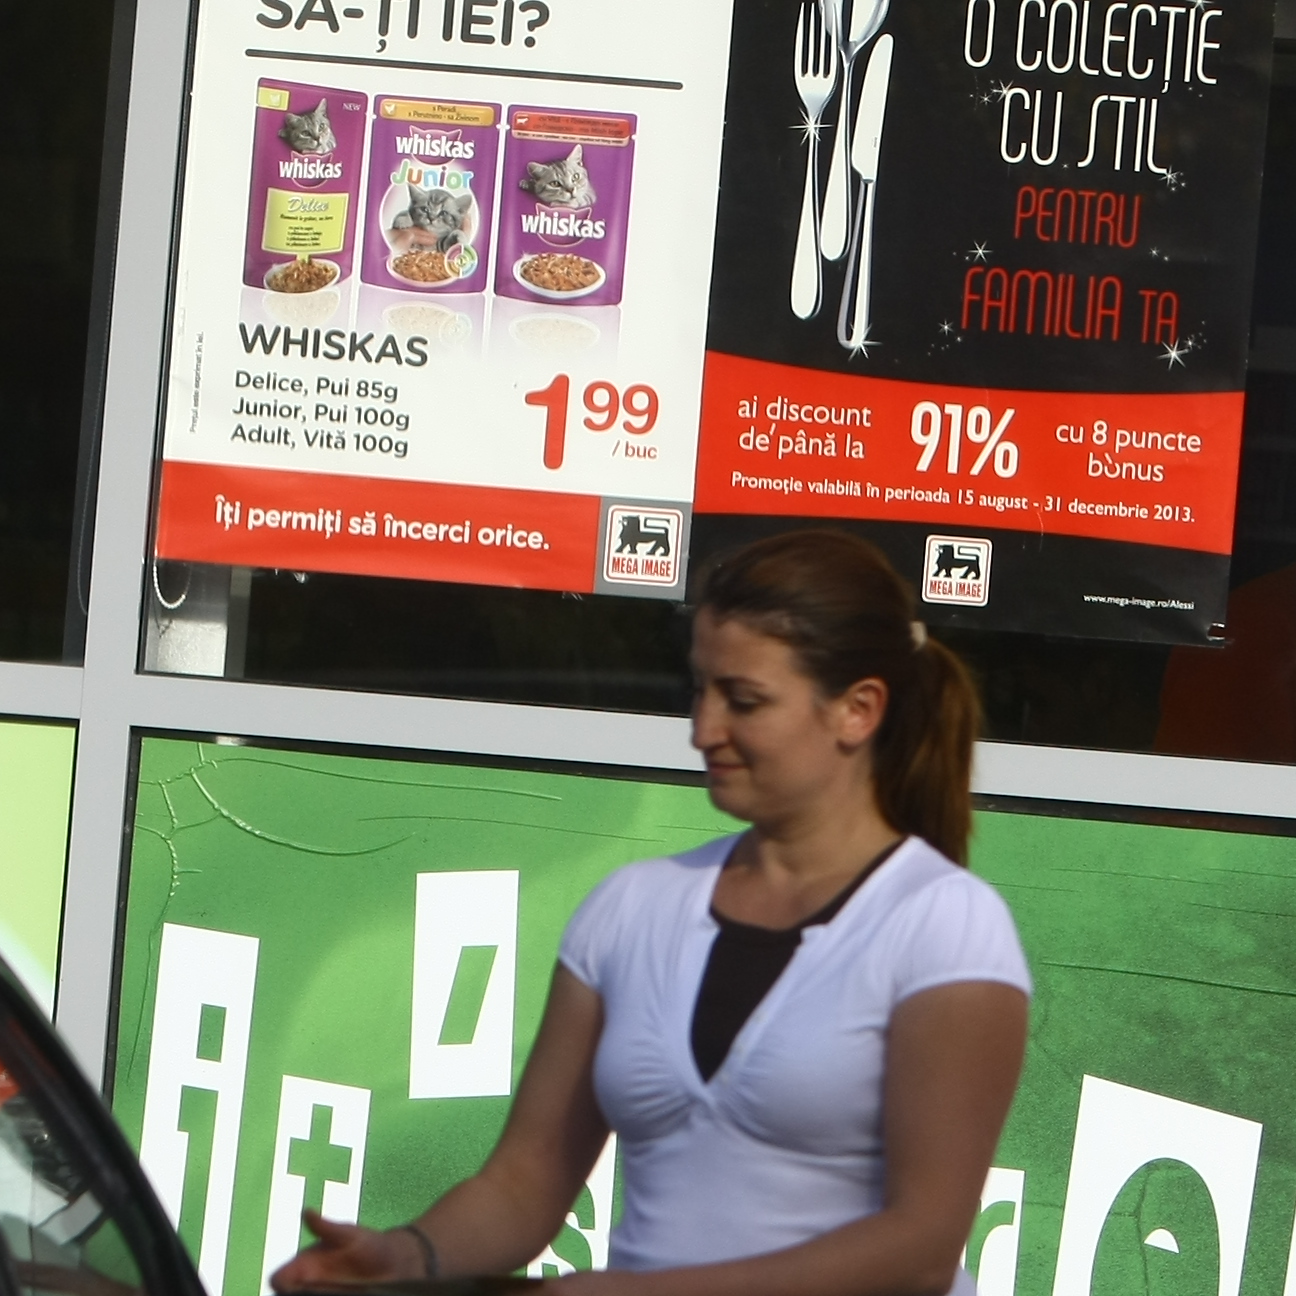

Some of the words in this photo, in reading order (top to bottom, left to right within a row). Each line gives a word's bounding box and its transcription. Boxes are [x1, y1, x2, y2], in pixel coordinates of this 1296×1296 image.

[962, 0, 997, 69] O
[1014, 0, 1224, 93] COLECȚIE
[999, 87, 1063, 167] CU
[396, 133, 475, 159] whiskas
[279, 158, 343, 180] whiskas
[391, 159, 474, 190] Junior
[521, 211, 605, 239] whiskas
[1013, 185, 1142, 248] PENTRU
[961, 266, 1124, 341] FAMILIA
[1138, 288, 1180, 346] TA
[239, 322, 429, 367] WHISKAS
[235, 370, 308, 396] Delice,
[316, 376, 349, 397] Pui
[356, 379, 398, 403] 85g
[232, 397, 306, 424] Junior,
[315, 403, 348, 424] Pui
[355, 407, 410, 431] 100g
[737, 396, 758, 419] ai
[766, 396, 872, 428] discount
[231, 423, 296, 450] Adult,
[304, 429, 347, 450] Vită
[353, 433, 409, 458] 100g
[624, 440, 658, 459] buc
[778, 428, 837, 460] până
[845, 433, 865, 459] la
[910, 400, 1019, 478] 91%
[1055, 423, 1084, 443] cu
[1092, 420, 1108, 446] 8
[1114, 428, 1202, 453] puncte
[731, 471, 803, 495] Promoție
[807, 478, 861, 497] valabilă
[866, 483, 880, 498] în
[884, 485, 950, 503] perioada
[957, 489, 974, 505] 15
[979, 493, 1028, 512] august
[1044, 496, 1061, 512] 31
[1068, 498, 1149, 519] decembrie
[1154, 504, 1195, 523] 2013.
[214, 494, 241, 532] Îți
[247, 507, 342, 540] permiți
[348, 511, 377, 537] să
[383, 513, 470, 544] încerci
[477, 522, 550, 550] orice.
[611, 556, 639, 576] MEGA
[641, 558, 672, 578] IMAGE
[929, 579, 953, 596] MEGA
[955, 581, 982, 598] IMAGE
